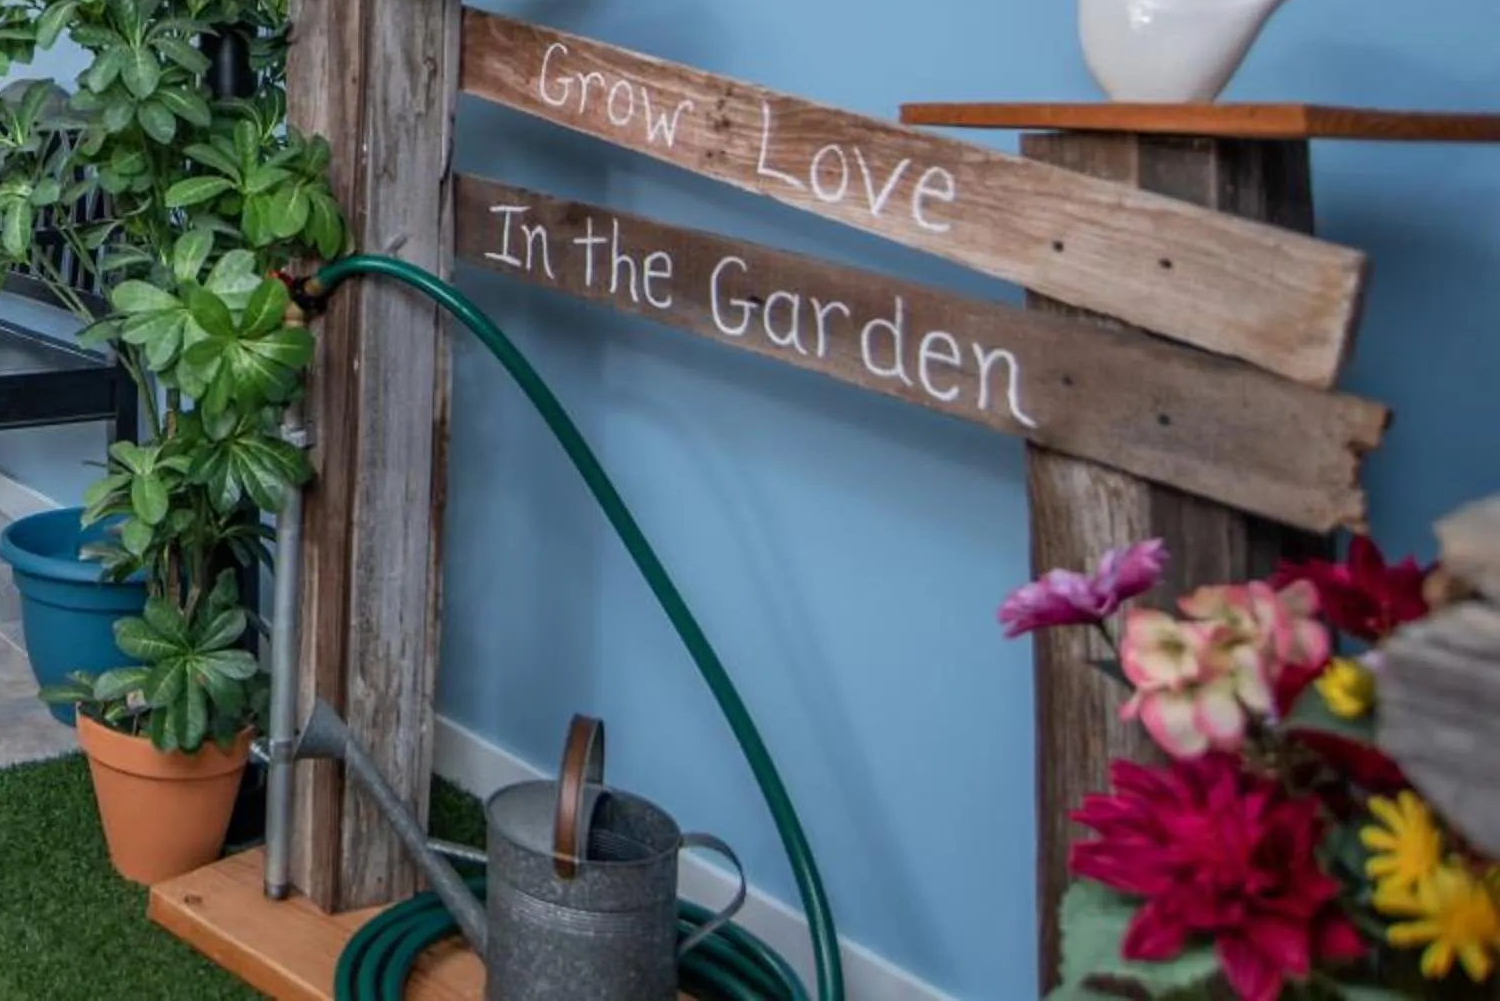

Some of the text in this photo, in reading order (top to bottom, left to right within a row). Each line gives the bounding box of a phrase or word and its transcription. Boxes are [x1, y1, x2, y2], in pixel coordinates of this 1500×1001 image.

[538, 42, 958, 233] Grow Love
[484, 204, 1039, 429] In the Garden
